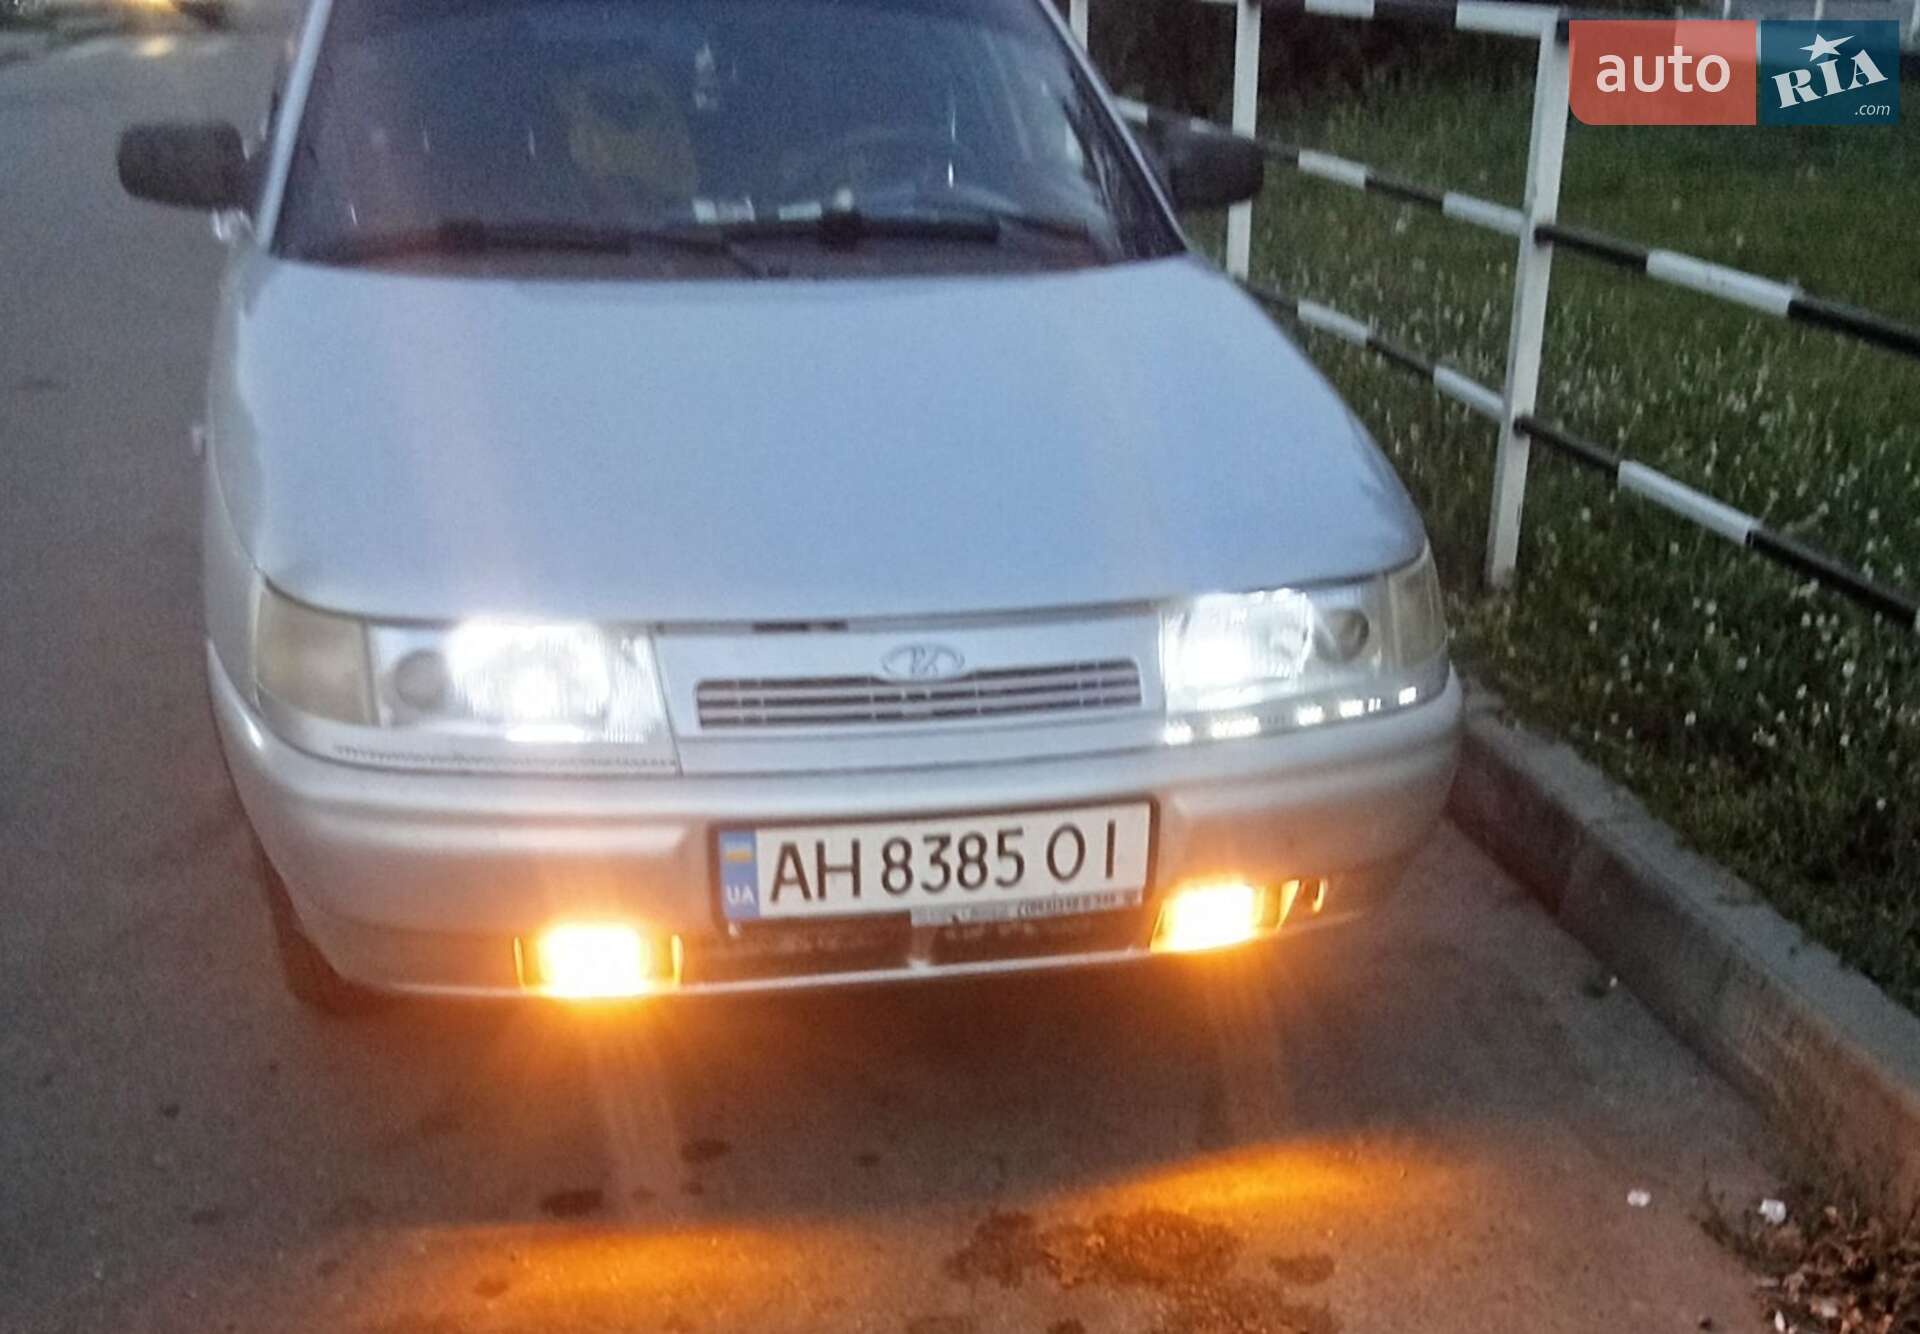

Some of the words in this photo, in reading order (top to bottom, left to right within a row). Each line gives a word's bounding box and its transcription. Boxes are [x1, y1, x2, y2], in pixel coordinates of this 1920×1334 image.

[769, 838, 862, 903] AH
[880, 826, 1026, 897] 8385
[725, 885, 756, 906] UA
